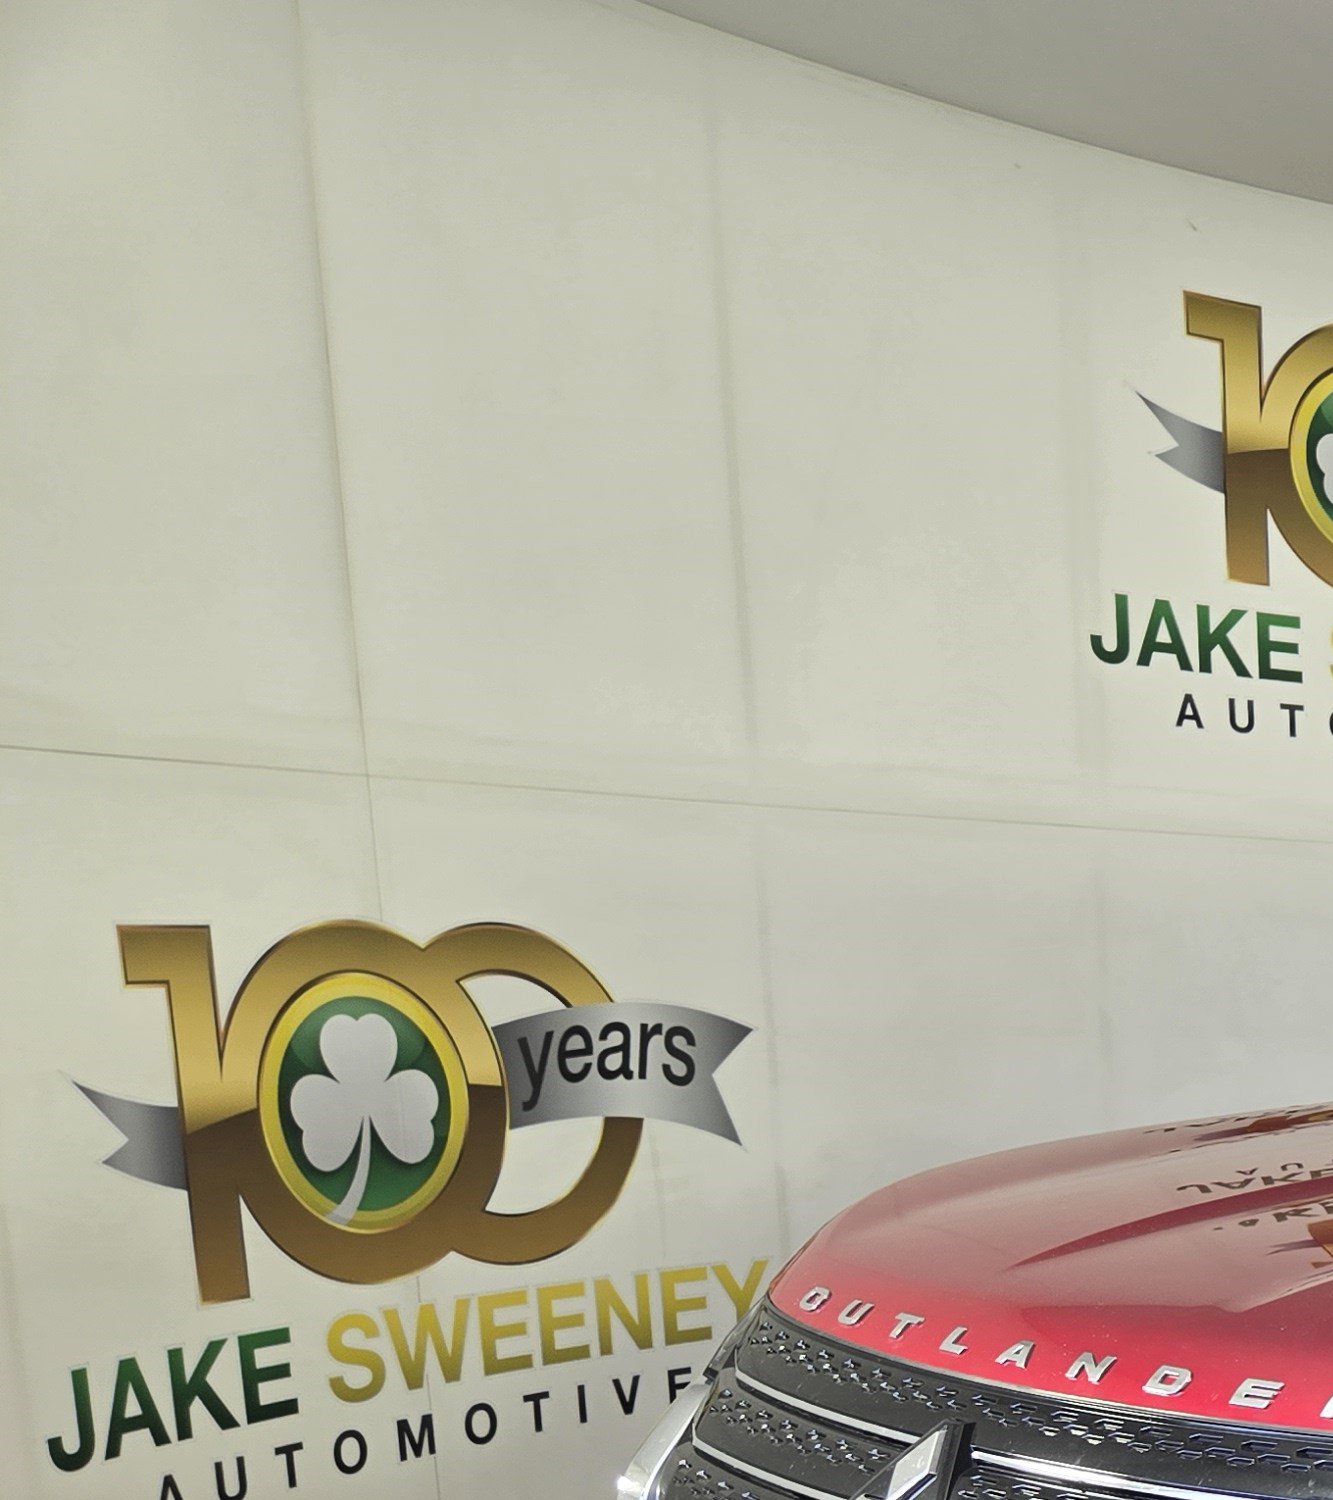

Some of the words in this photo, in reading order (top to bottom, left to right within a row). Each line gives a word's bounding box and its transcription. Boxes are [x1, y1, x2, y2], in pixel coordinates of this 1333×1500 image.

[1089, 592, 1303, 685] JAKE
[517, 1019, 697, 1111] years
[47, 1327, 299, 1472] JAKE
[325, 1259, 769, 1404] SWEENEY
